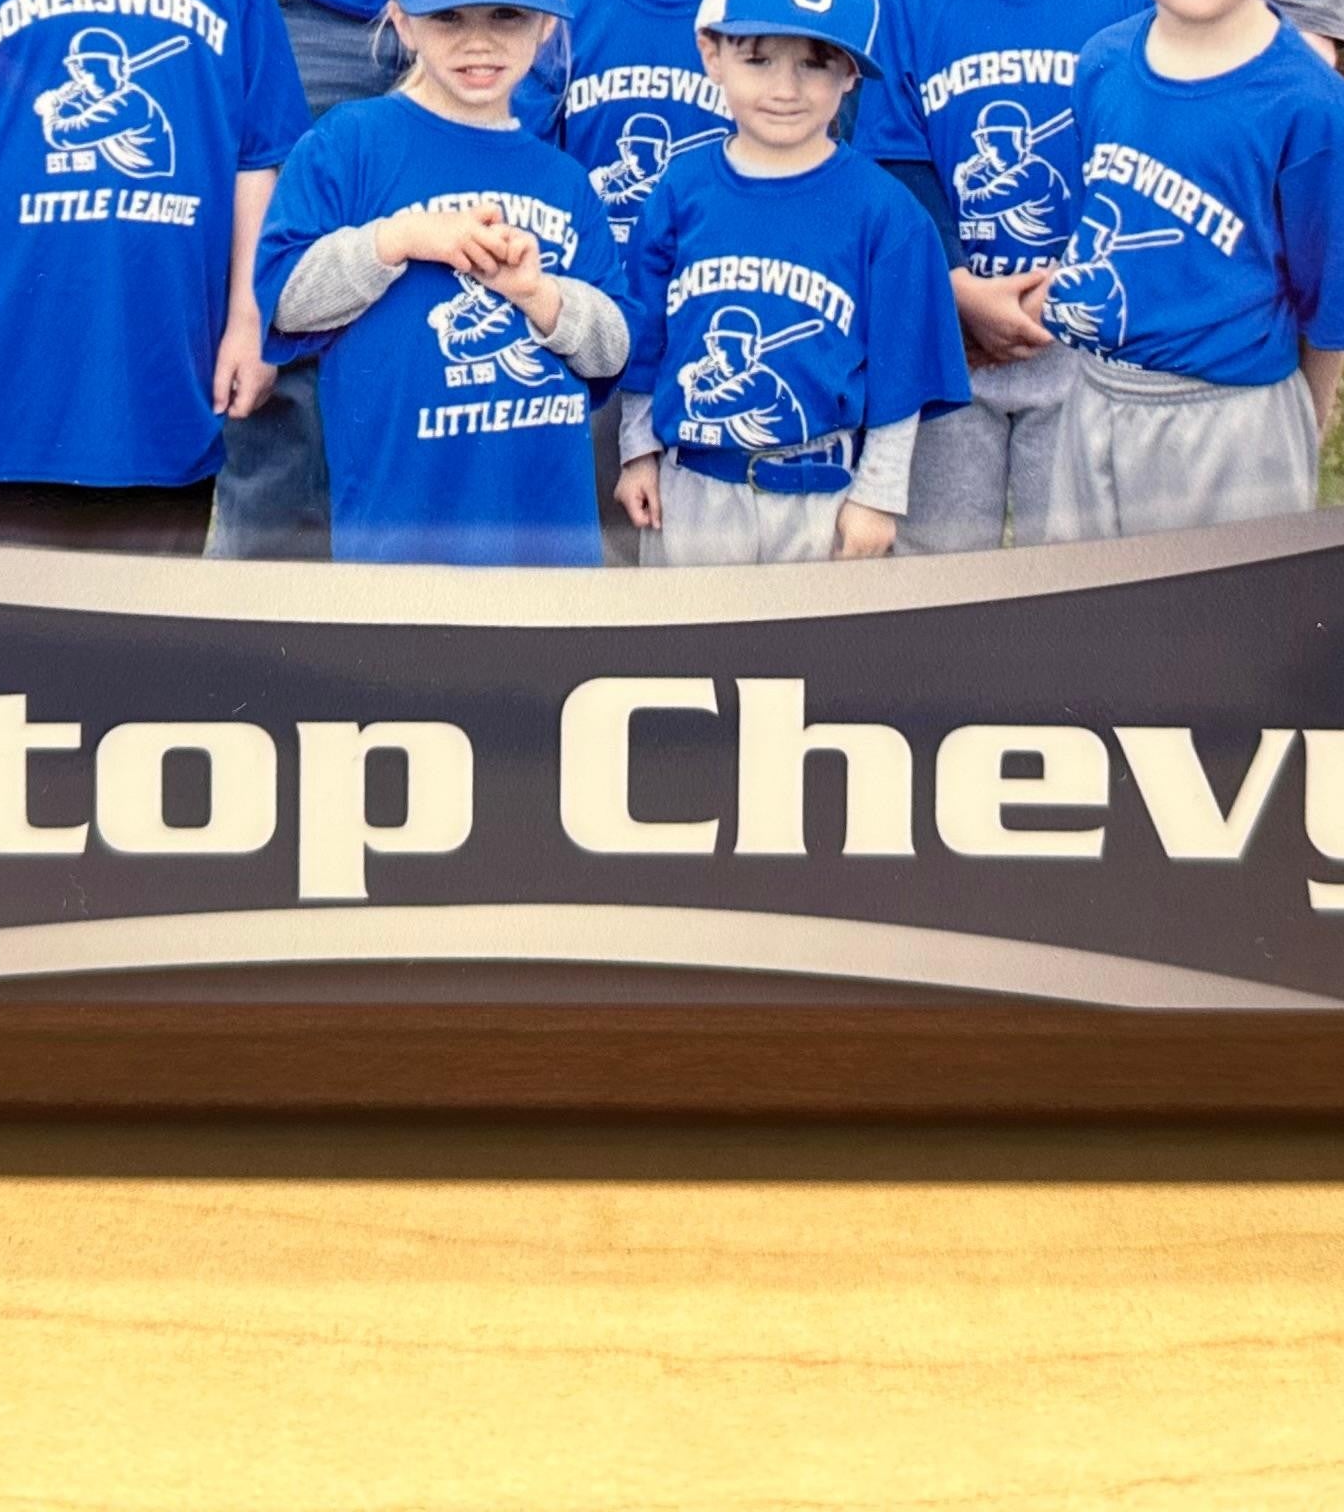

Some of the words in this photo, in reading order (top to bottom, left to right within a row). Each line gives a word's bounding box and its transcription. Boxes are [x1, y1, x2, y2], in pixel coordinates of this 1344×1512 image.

[919, 49, 1080, 117] OMERSWO
[18, 188, 112, 224] LITTLE
[115, 189, 201, 226] LEAGUE
[666, 255, 856, 337] SMERSWORTH
[417, 399, 512, 439] LITTLE
[512, 392, 586, 429] LEAGUE
